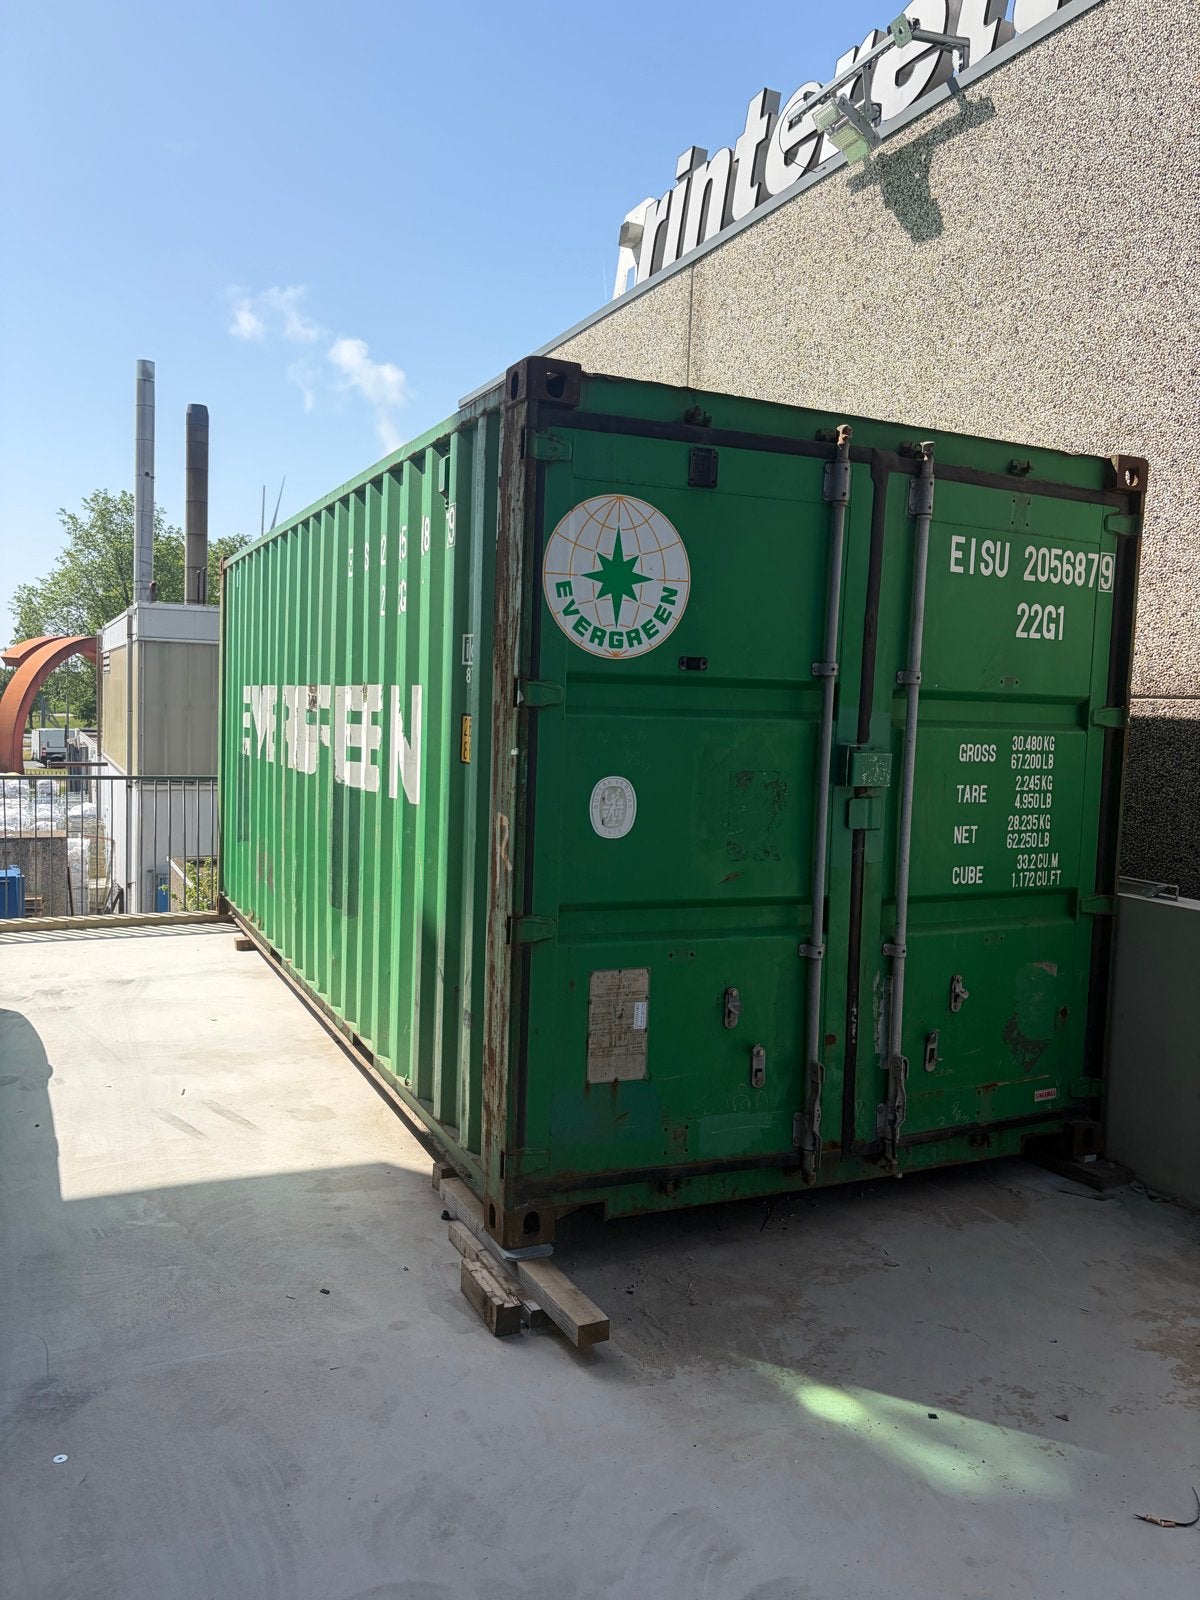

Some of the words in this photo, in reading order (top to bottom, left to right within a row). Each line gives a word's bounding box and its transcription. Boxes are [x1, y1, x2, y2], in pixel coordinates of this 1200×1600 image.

[950, 535, 1011, 578] EISU
[1023, 545, 1114, 590] 2056879
[555, 580, 679, 649] EVERGREEN
[1015, 602, 1065, 640] 22G1
[1012, 735, 1042, 751] 30.480
[1043, 736, 1055, 751] KG
[959, 744, 997, 762] GROSS
[1011, 754, 1042, 769] 67.200
[1043, 754, 1054, 769] LB
[1016, 775, 1041, 791] 2.245
[1042, 775, 1053, 790] KG
[957, 784, 988, 803] TARE
[1014, 794, 1040, 809] 4.950
[1041, 793, 1052, 809] LB
[1008, 815, 1038, 831] 28.235
[1039, 814, 1051, 830] KG
[954, 825, 978, 844] NET
[1006, 833, 1038, 848] 62.250
[1039, 833, 1050, 847] LB
[1016, 854, 1036, 869] 33.2
[952, 866, 984, 884] CUBE
[1012, 872, 1035, 888] 1.172
